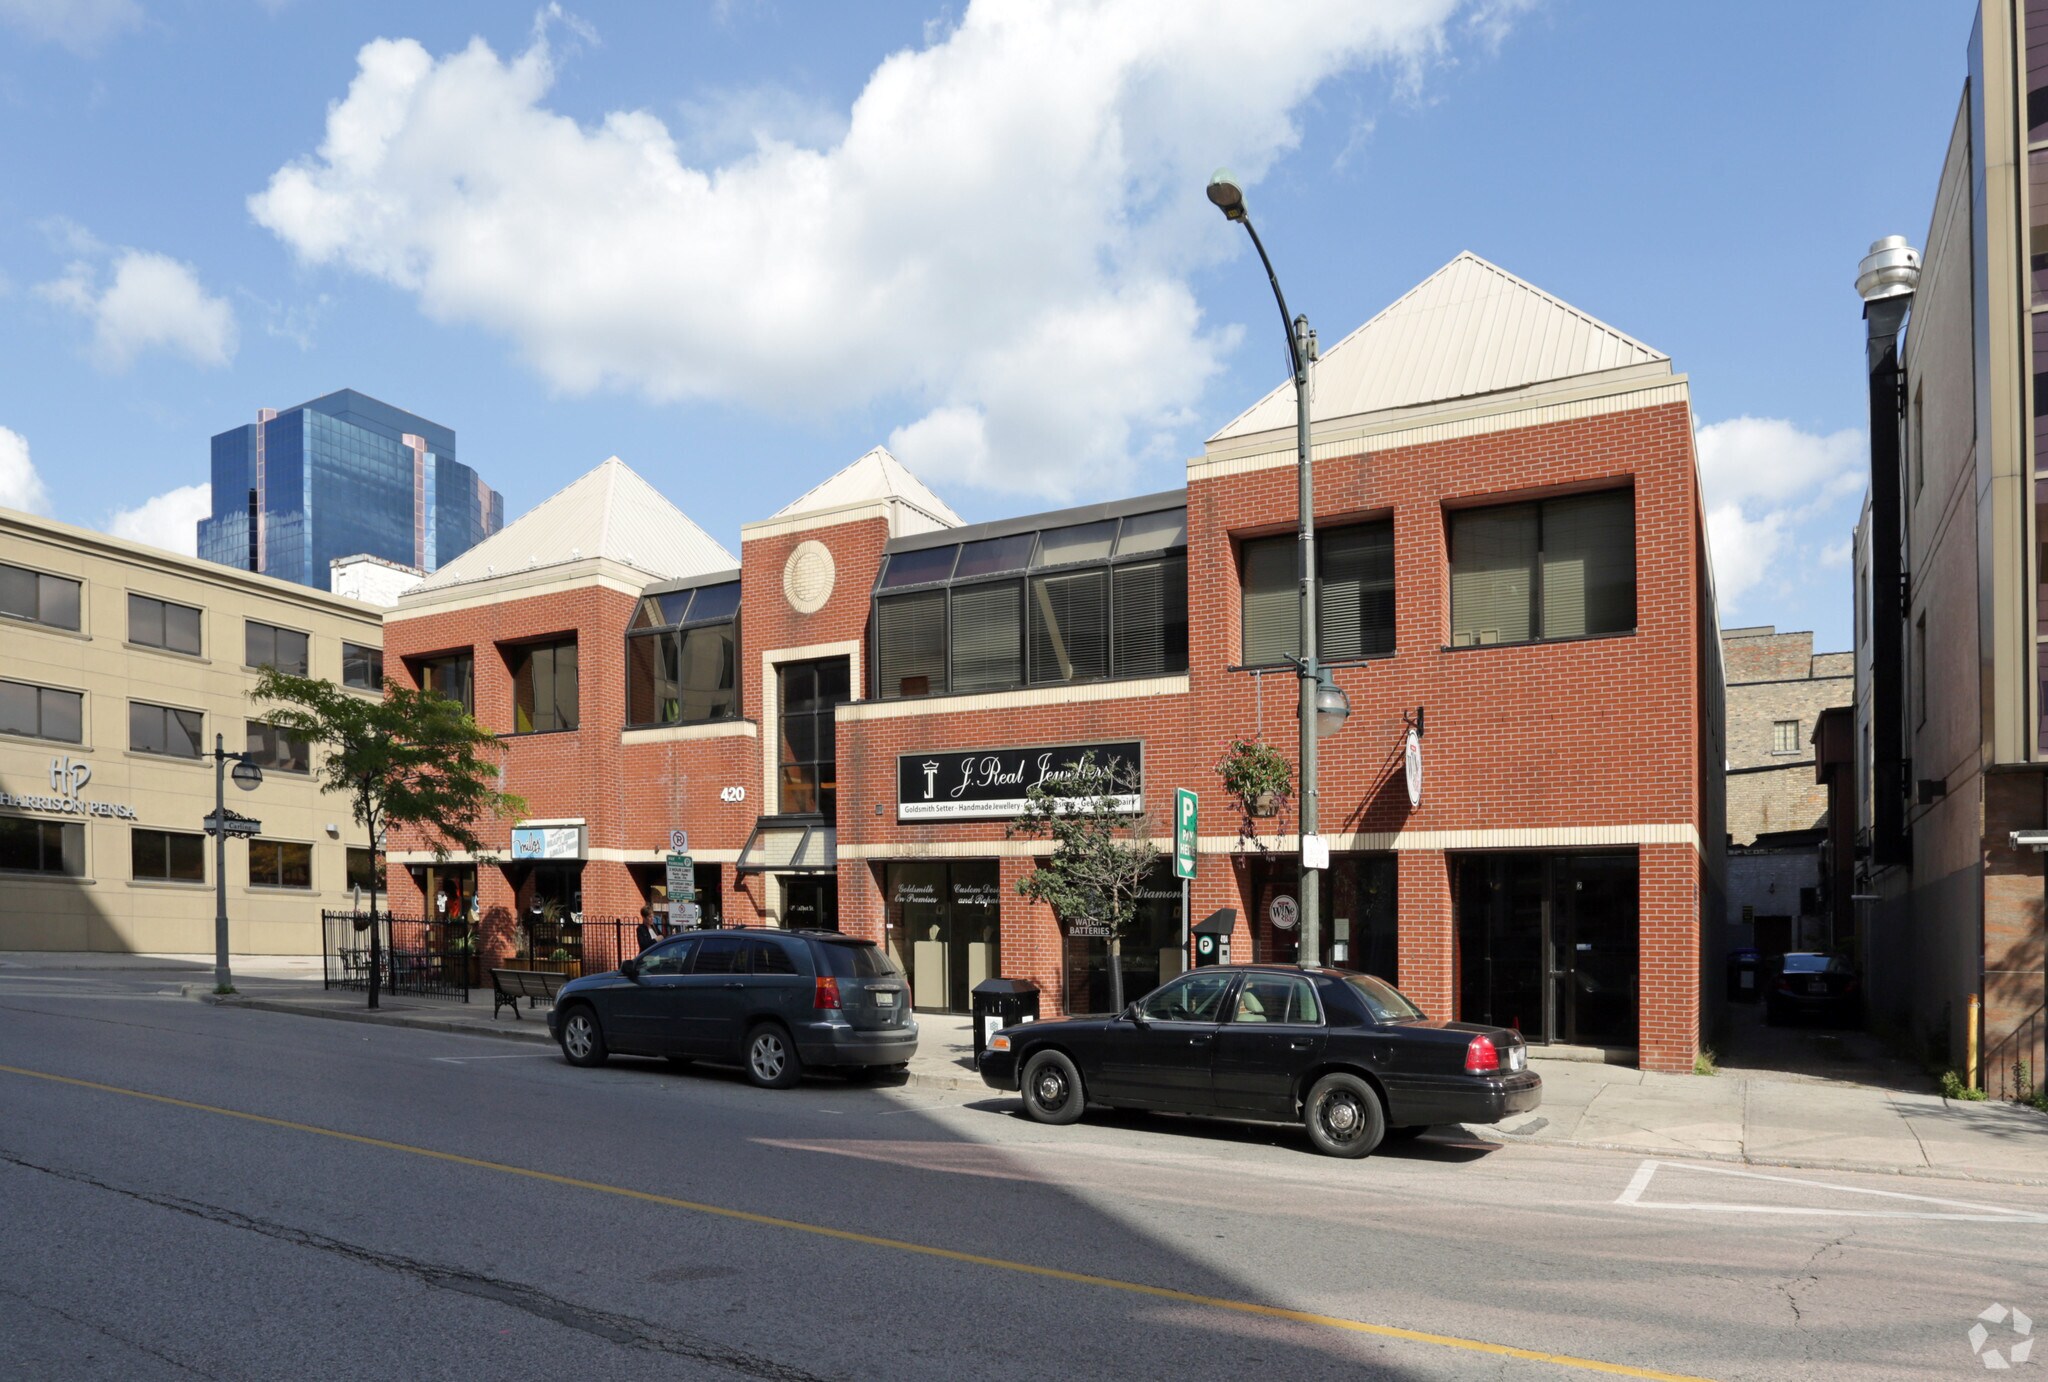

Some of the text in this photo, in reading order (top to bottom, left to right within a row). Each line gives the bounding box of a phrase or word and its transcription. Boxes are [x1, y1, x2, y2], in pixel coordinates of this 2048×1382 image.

[50, 755, 91, 799] HP
[950, 757, 975, 798] J.
[976, 756, 1025, 787] Real
[720, 787, 745, 802] 420
[0, 792, 135, 817] HARRISON PENSA
[904, 804, 936, 814] Goldsmith
[936, 803, 954, 812] Setter
[958, 802, 992, 811] Handmade
[992, 801, 1020, 811] Jewellery
[1183, 797, 1194, 826] P
[1182, 829, 1194, 842] PAY
[898, 884, 934, 893] Goldsmith
[954, 884, 981, 893] Custom
[907, 894, 938, 903] Premises
[958, 895, 973, 903] and
[1069, 926, 1110, 935] BATTERIES
[1202, 940, 1210, 951] P
